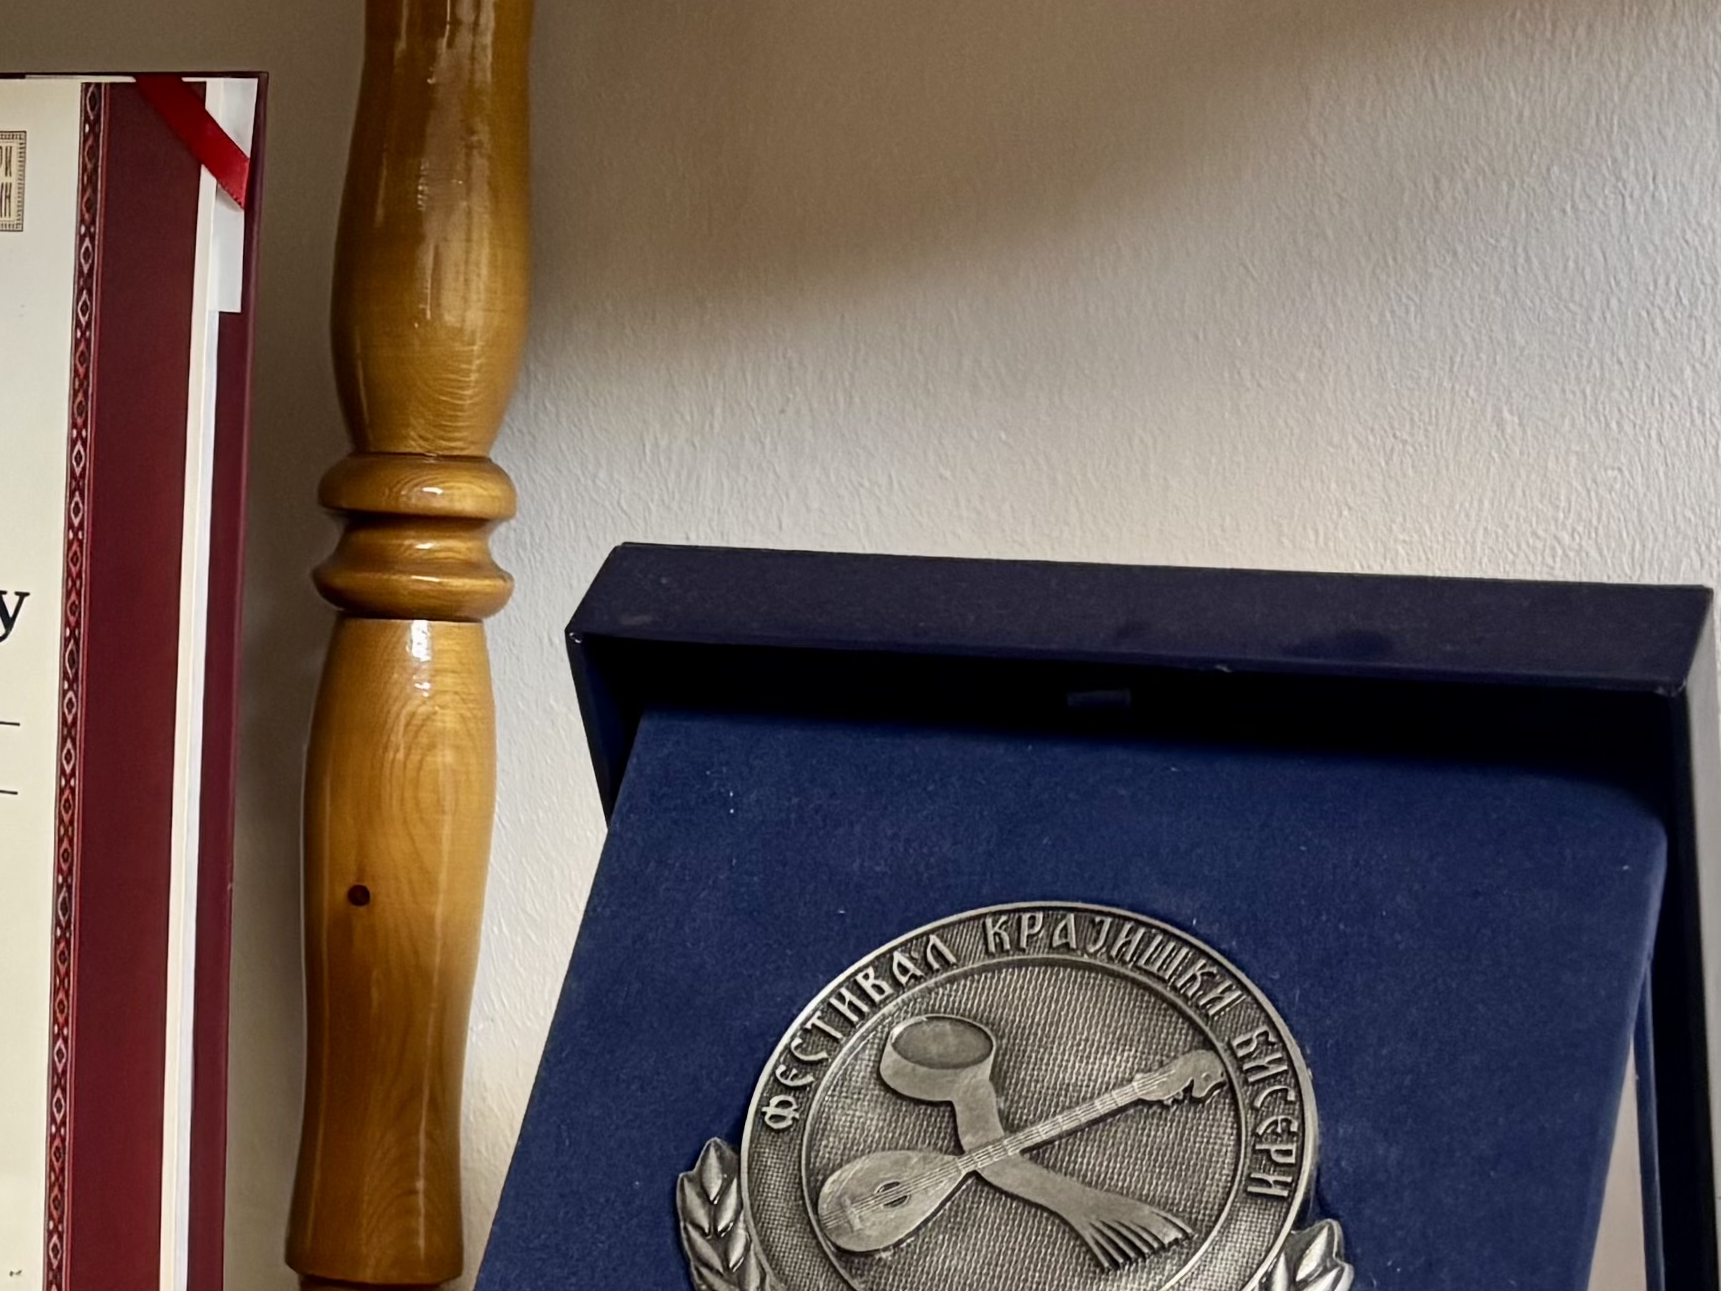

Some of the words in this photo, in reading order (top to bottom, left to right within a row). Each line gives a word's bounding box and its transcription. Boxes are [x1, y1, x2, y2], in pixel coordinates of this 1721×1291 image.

[762, 933, 958, 1131] ФЕСТИВАЛ
[983, 911, 1244, 1019] КРАЈИШКИ
[1234, 1025, 1299, 1199] БИСЕРИ
